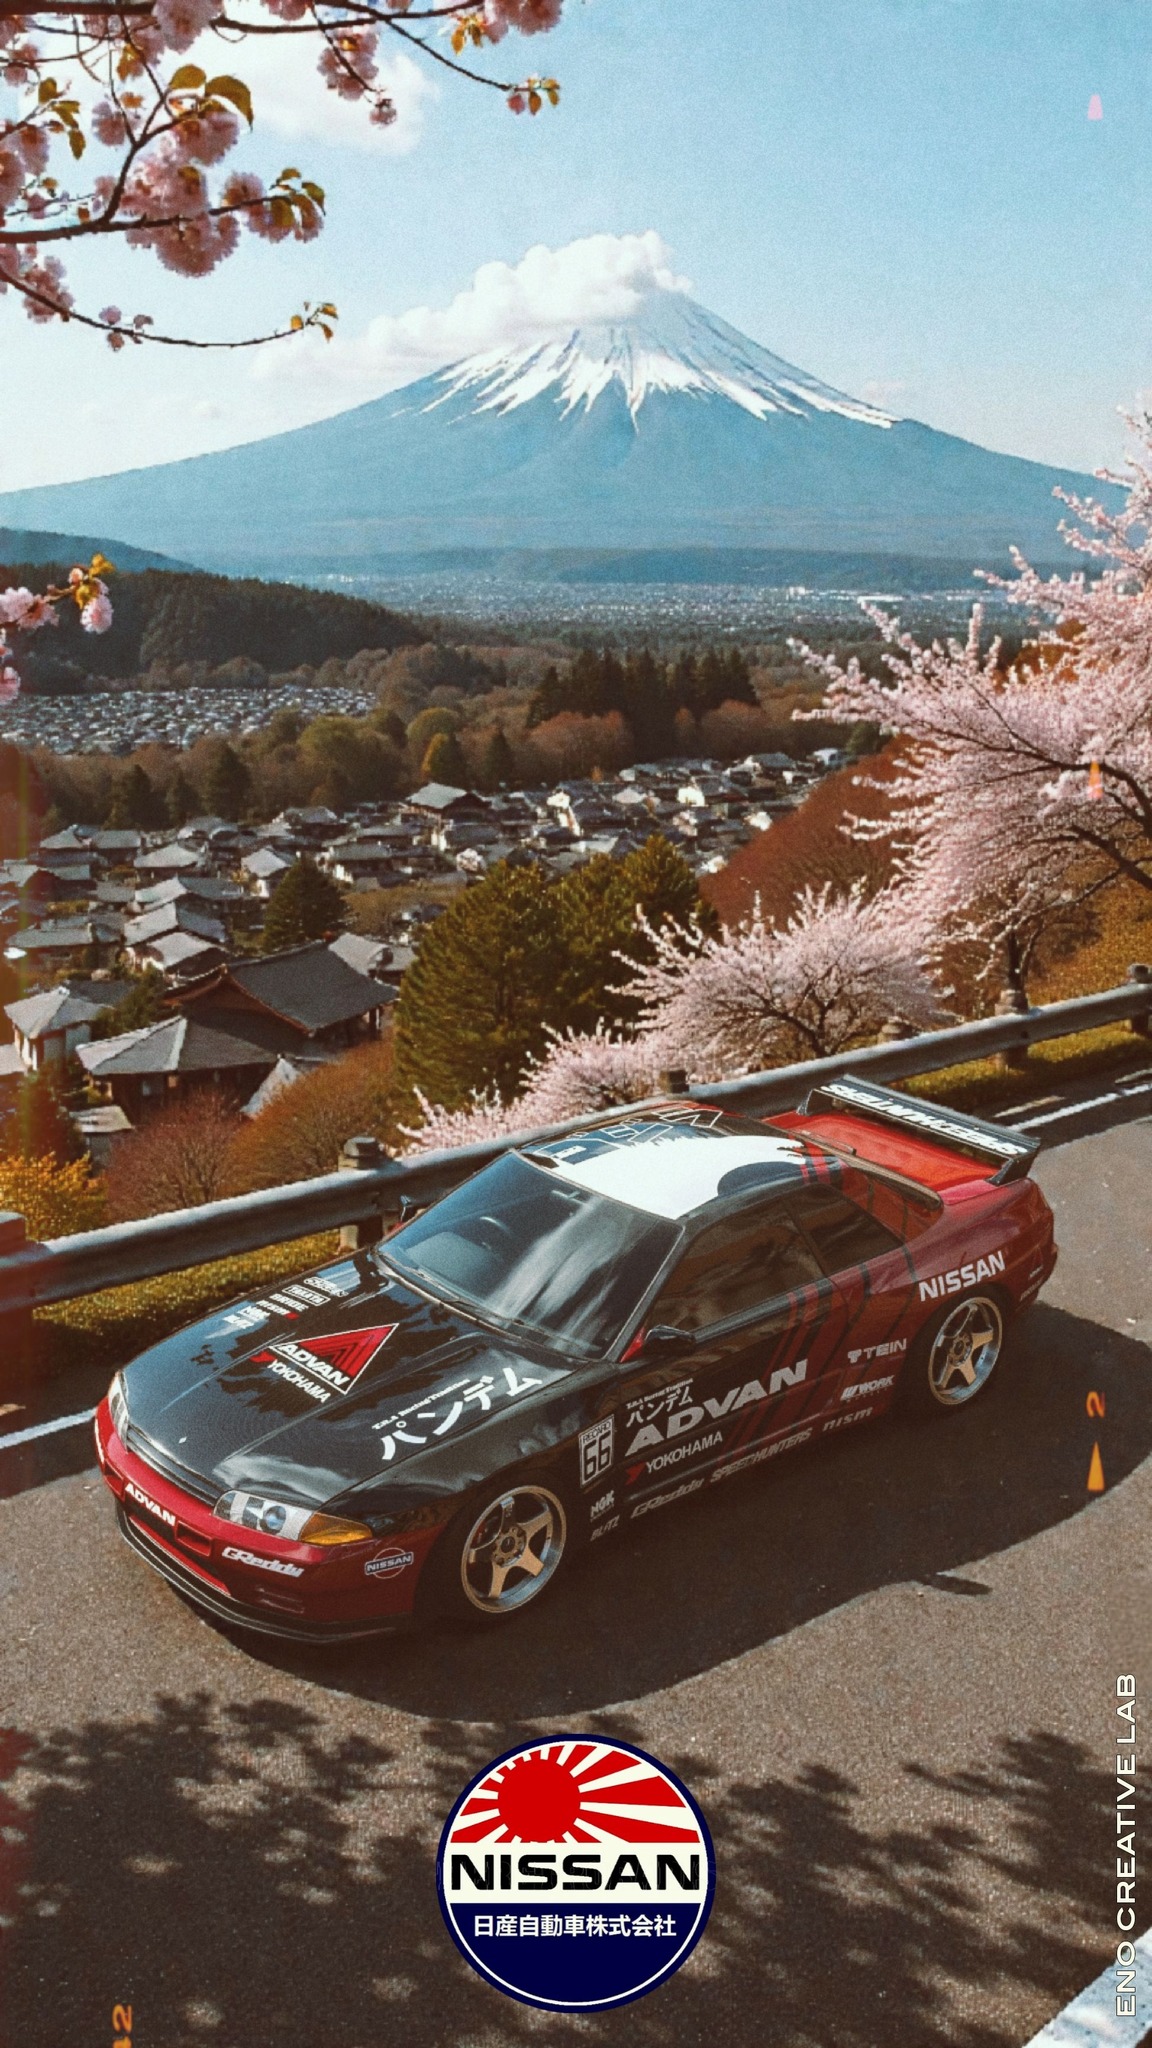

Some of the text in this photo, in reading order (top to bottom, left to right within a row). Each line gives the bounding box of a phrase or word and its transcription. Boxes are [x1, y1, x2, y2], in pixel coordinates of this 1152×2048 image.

[918, 1250, 1006, 1302] NISSAN
[269, 1294, 309, 1312] BRIDE
[278, 1343, 350, 1386] ADVAN
[863, 1338, 907, 1360] TEIN
[267, 1359, 332, 1404] YOKOHAMA
[381, 1367, 543, 1461] パンデム
[625, 1386, 694, 1428] パンデム
[625, 1359, 808, 1457] ADVAN
[582, 1420, 612, 1443] RECARO
[645, 1431, 723, 1474] YOKOHAMA
[583, 1430, 612, 1482] 66
[710, 1427, 814, 1484] SPEEDHUNTERS
[124, 1483, 176, 1527] ADVAN
[590, 1490, 615, 1518] NGK
[366, 1554, 412, 1573] NISSAN
